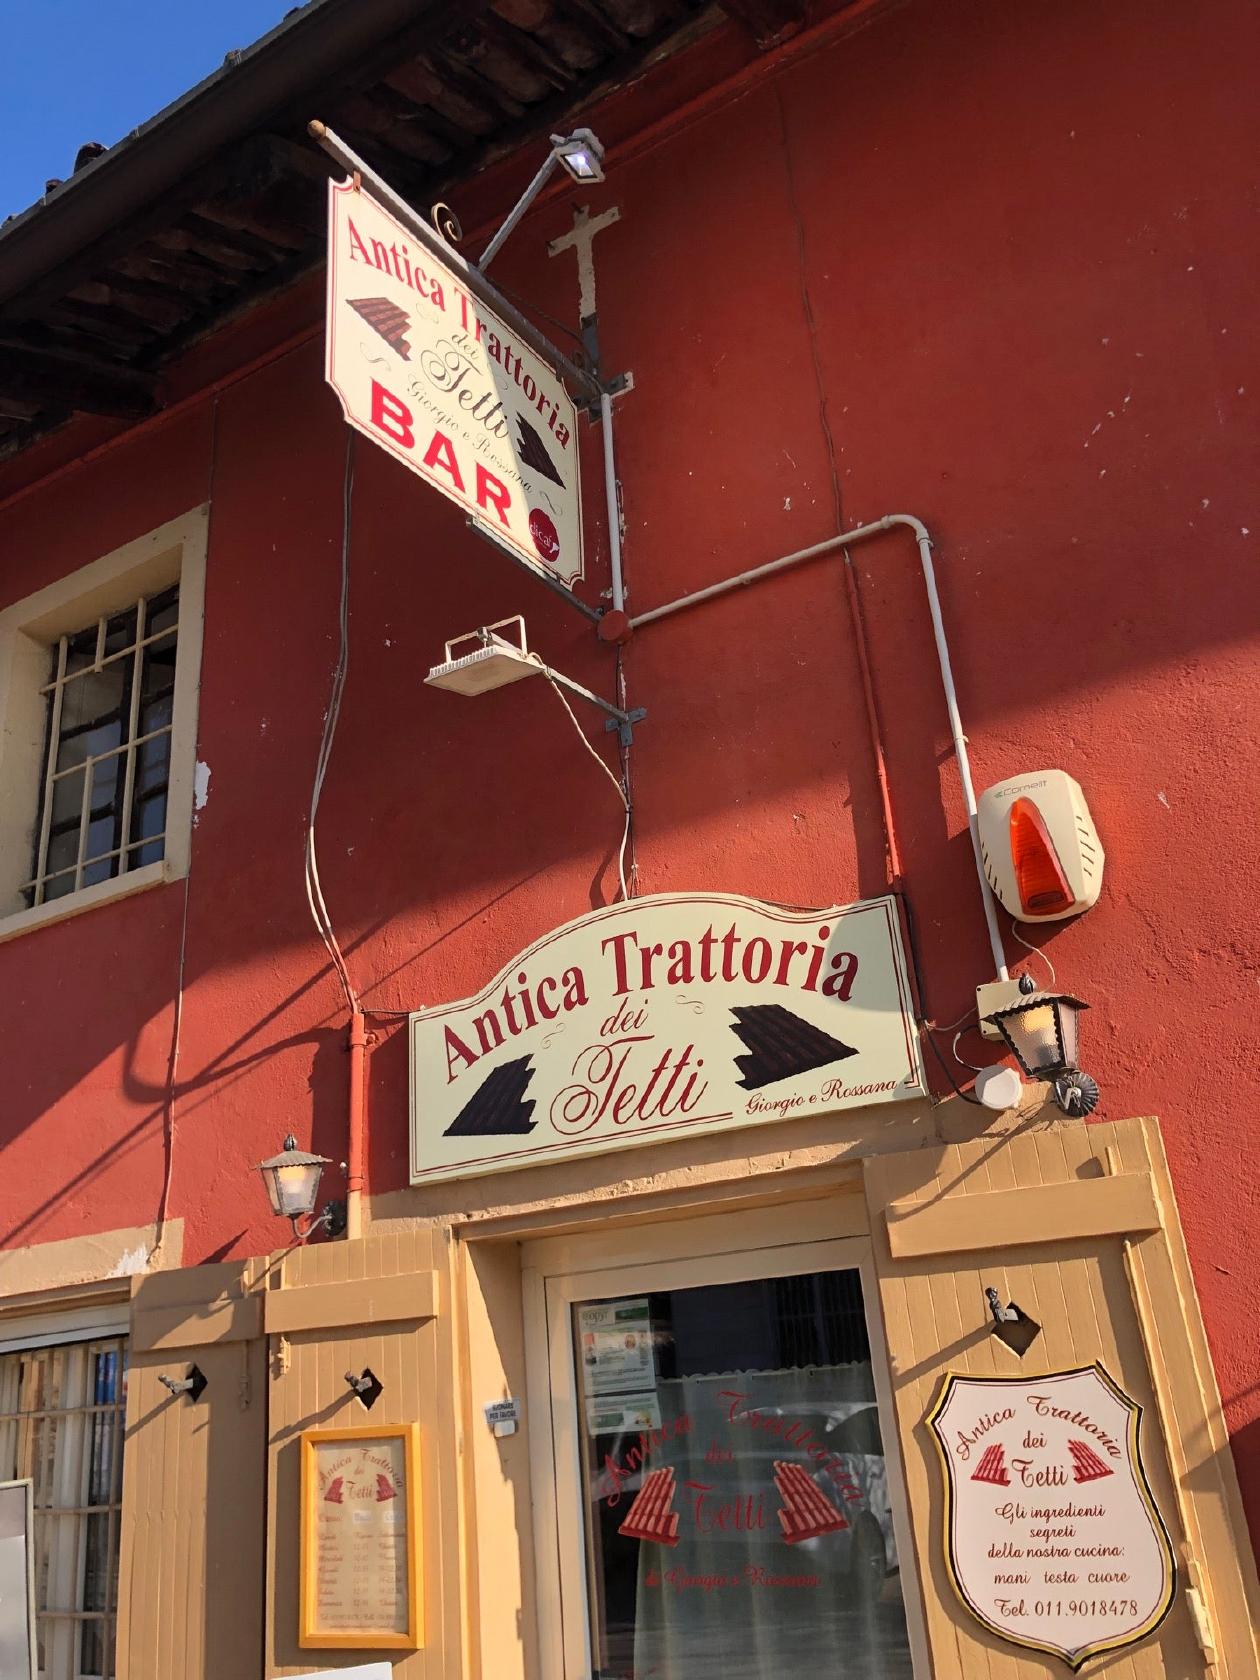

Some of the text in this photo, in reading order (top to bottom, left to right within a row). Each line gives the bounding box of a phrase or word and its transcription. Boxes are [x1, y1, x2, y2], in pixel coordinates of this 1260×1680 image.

[347, 214, 570, 450] Antica Trattoria
[451, 332, 481, 361] dei
[420, 338, 510, 439] Tetti
[370, 376, 511, 529] BAR
[407, 374, 533, 493] Giorgio e Rossana
[441, 921, 860, 1085] Antica Trattoria
[600, 996, 649, 1038] dei
[550, 1034, 710, 1136] Tetti
[745, 1077, 897, 1118] Giorgio e Rossana
[956, 1394, 1122, 1461] Antica Trattoria
[1022, 1430, 1048, 1449] dei
[1011, 1458, 1070, 1488] Tetti
[995, 1502, 1106, 1525] Gli ingredienti
[988, 1543, 1126, 1559] della nostra cucina:
[1029, 1525, 1077, 1544] segreti
[994, 1570, 1131, 1585] mani testa cuore
[994, 1598, 1139, 1618] Tel. 011.9018478
